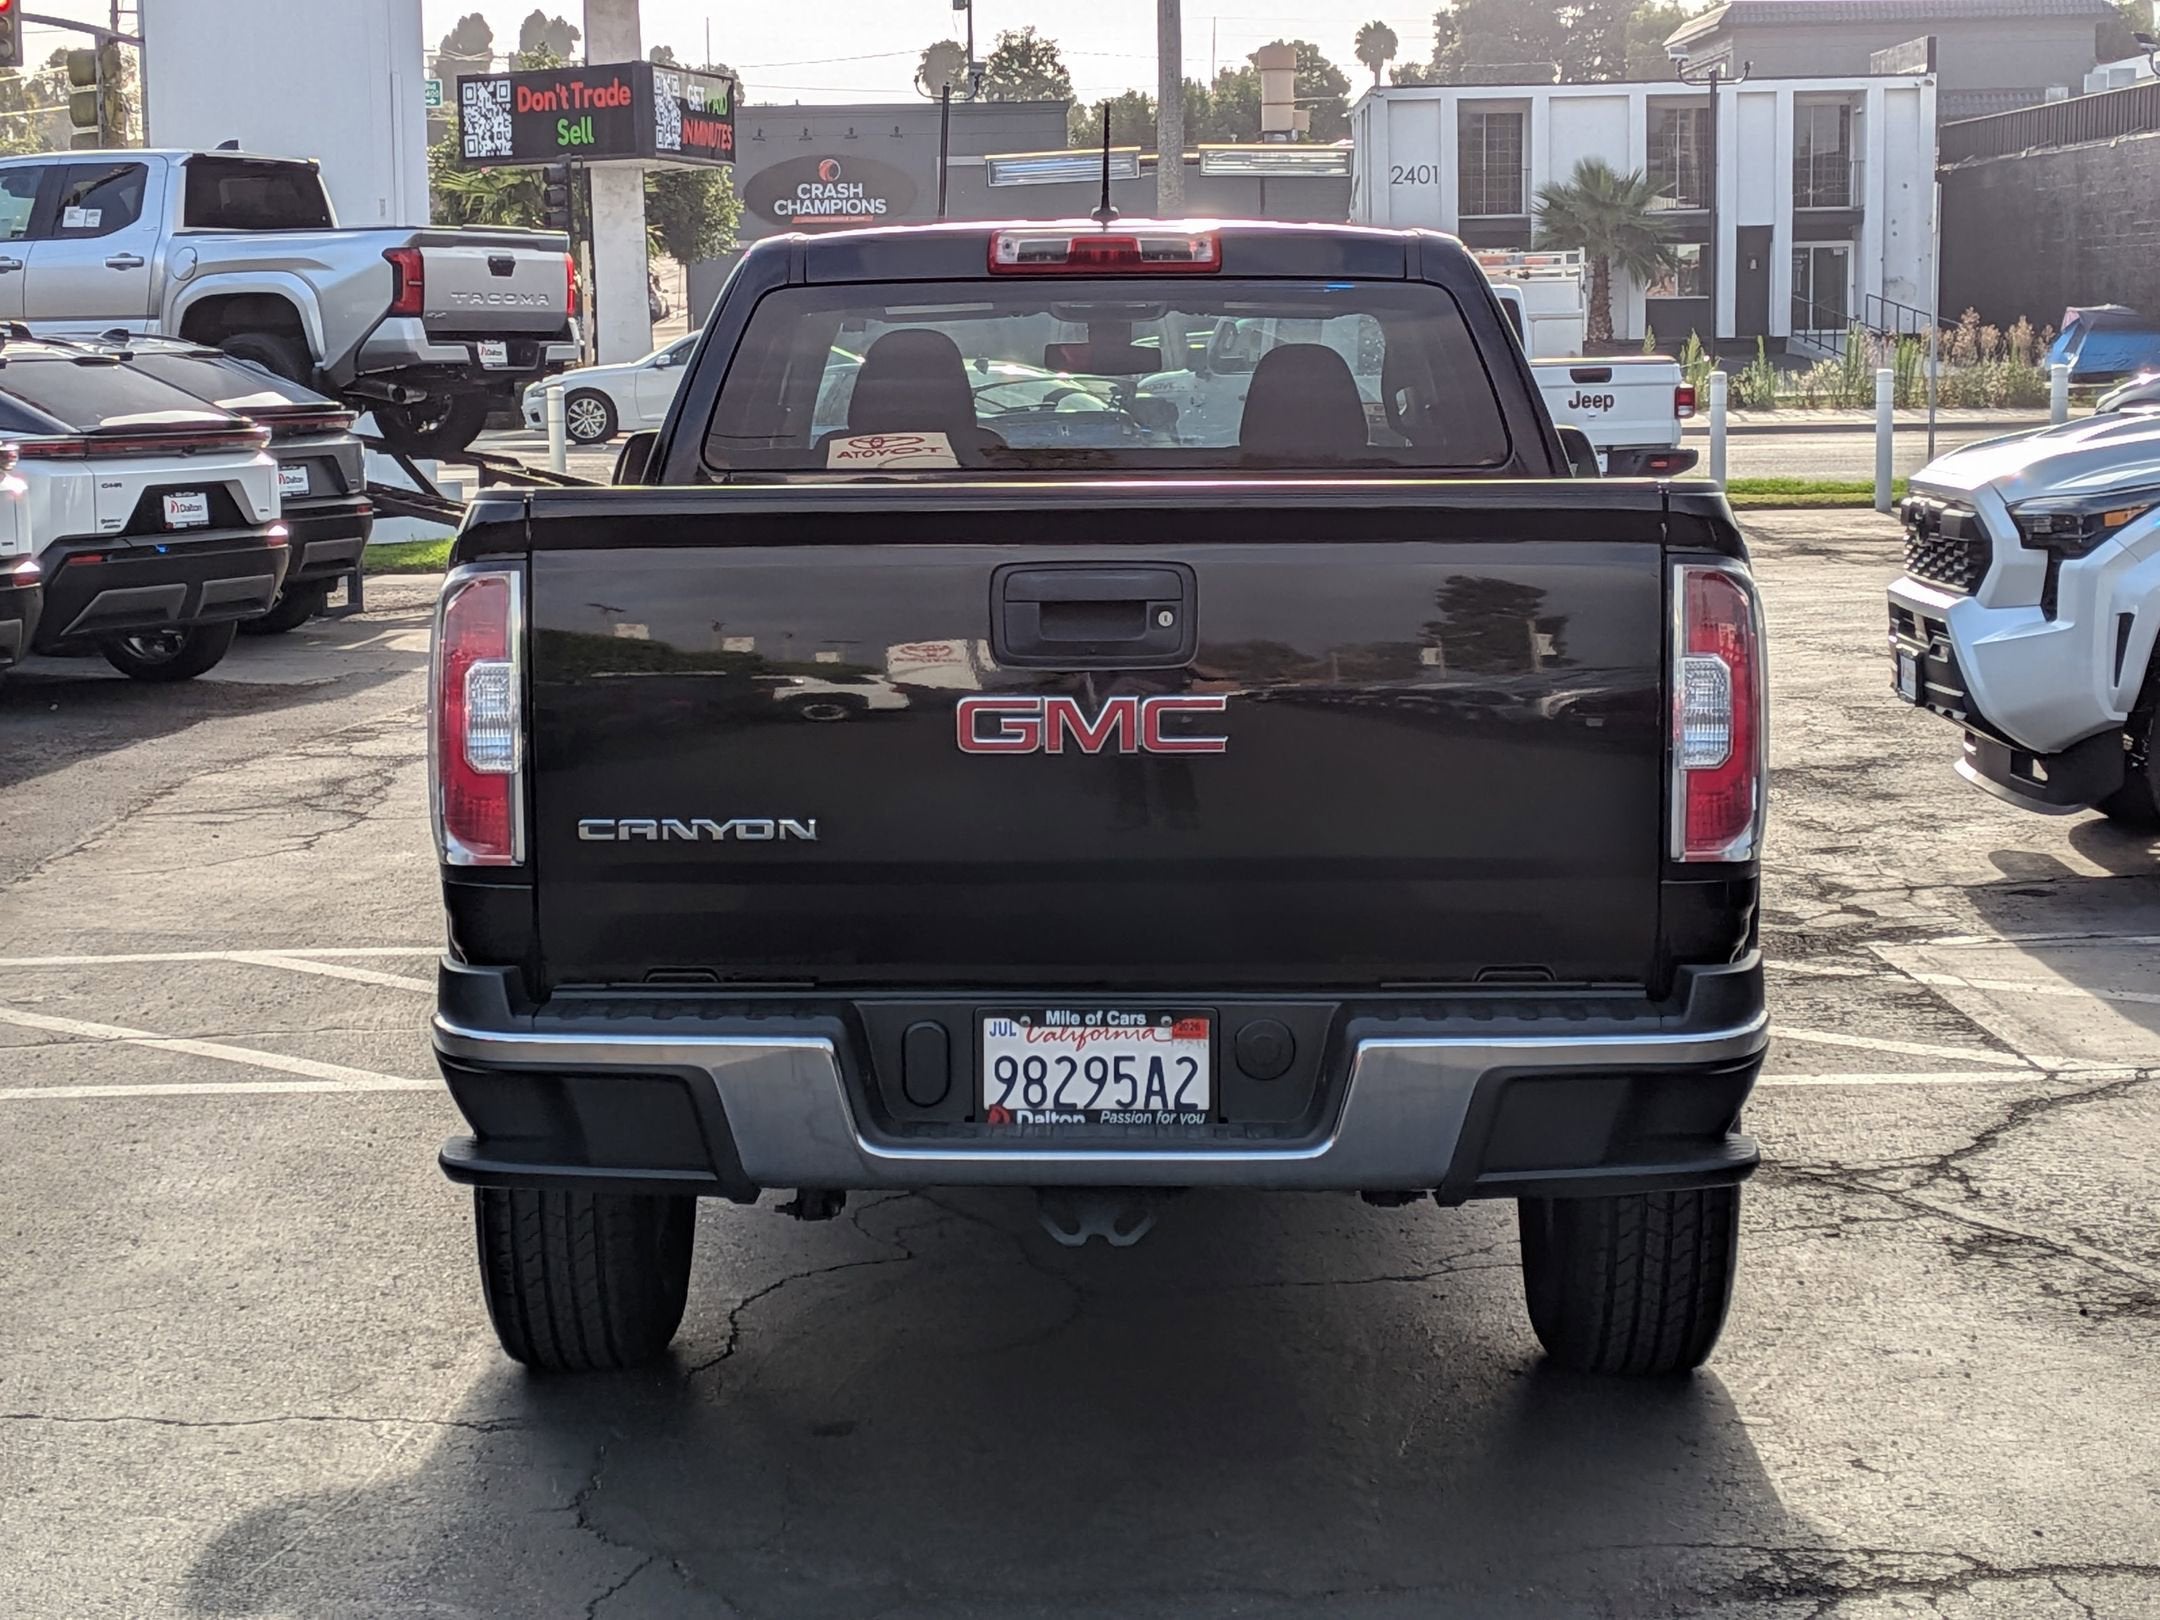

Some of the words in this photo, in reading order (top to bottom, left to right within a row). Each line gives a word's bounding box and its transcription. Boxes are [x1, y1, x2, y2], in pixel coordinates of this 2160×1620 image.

[517, 82, 569, 113] Don't
[570, 78, 631, 109] Trade
[687, 84, 705, 112] GET
[557, 116, 594, 146] Sell
[1390, 164, 1439, 185] 2401
[797, 183, 863, 199] CRASH
[773, 198, 887, 215] CHAMPIONS
[450, 292, 549, 306] TACOMA
[1568, 390, 1615, 412] Jeep
[180, 503, 203, 513] Dalton
[957, 695, 1228, 753] GMC
[578, 819, 818, 841] CANYON
[1046, 1010, 1079, 1025] Mile
[1085, 1010, 1101, 1025] of
[1107, 1010, 1147, 1025] Cars
[989, 1021, 1017, 1037] JUL
[1026, 1026, 1172, 1051] California
[994, 1055, 1199, 1110] 98295A2
[1017, 1109, 1086, 1124] Dalton
[1100, 1110, 1151, 1124] Passion
[1155, 1110, 1176, 1125] for
[1180, 1112, 1205, 1125] you
